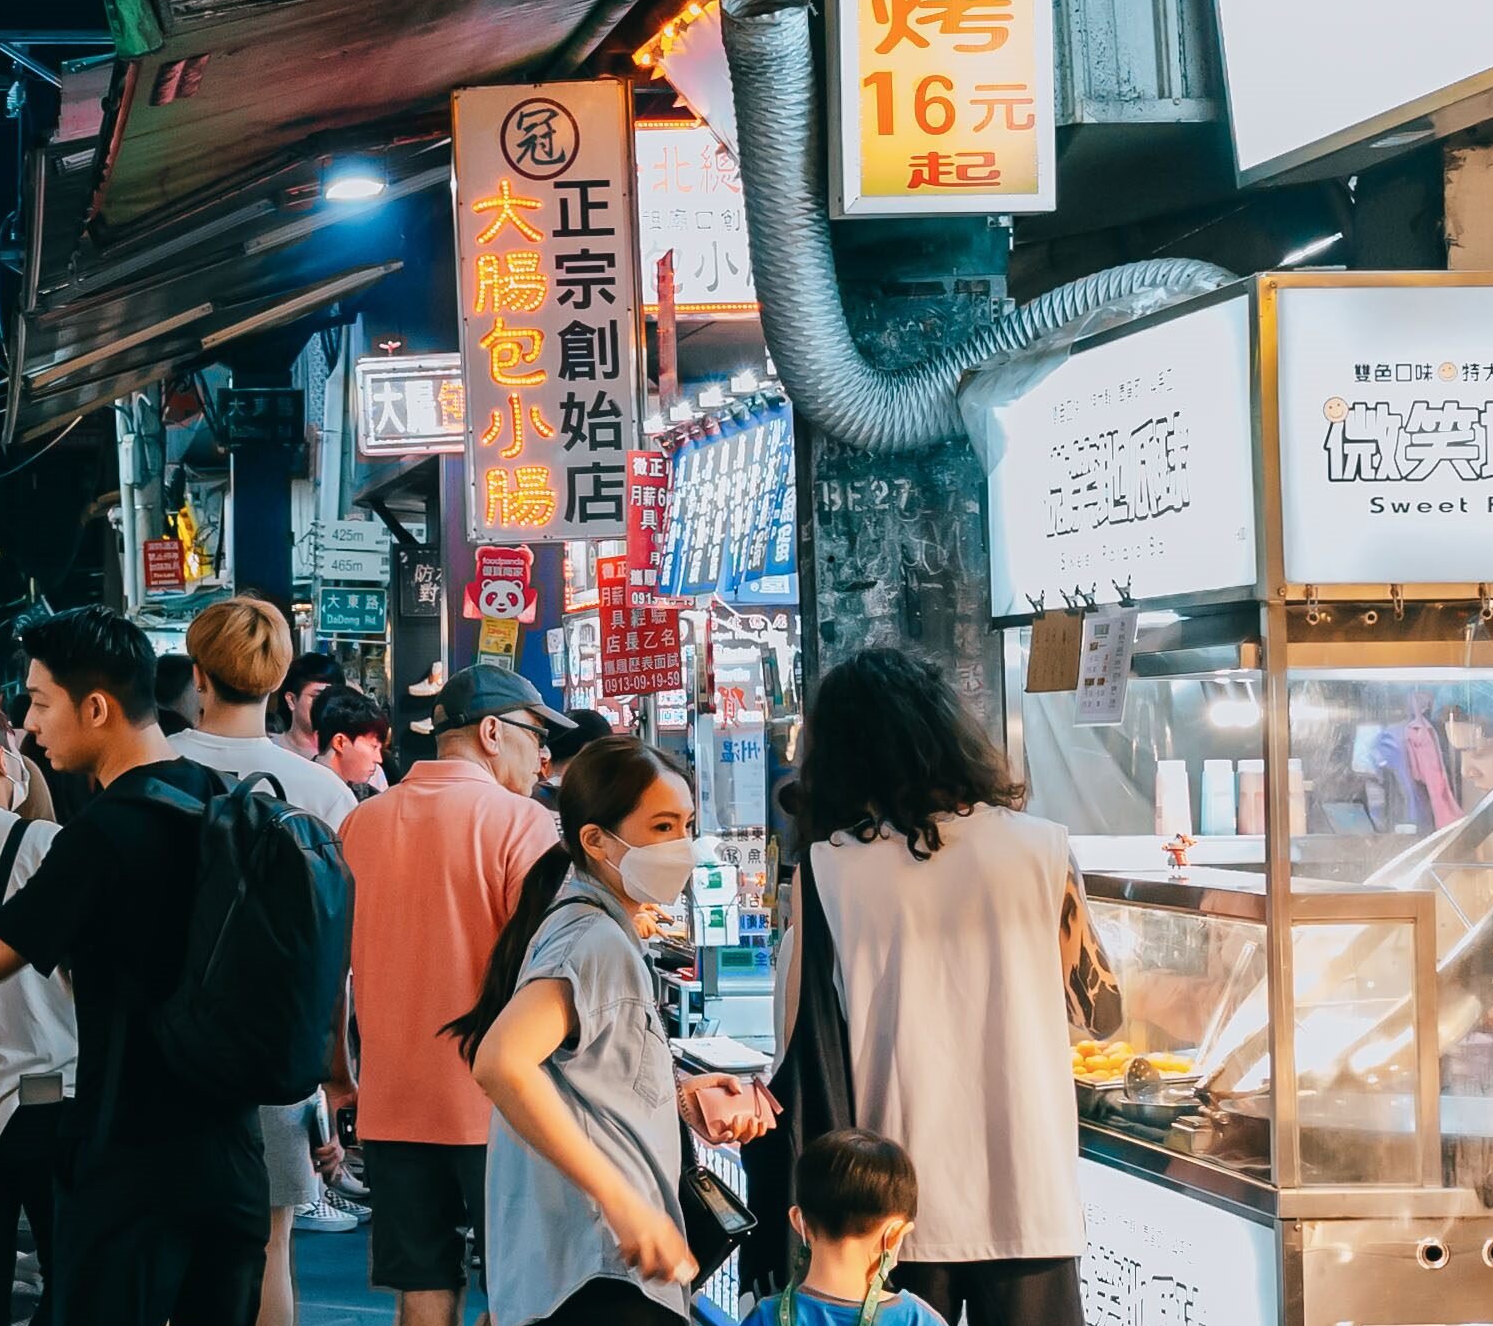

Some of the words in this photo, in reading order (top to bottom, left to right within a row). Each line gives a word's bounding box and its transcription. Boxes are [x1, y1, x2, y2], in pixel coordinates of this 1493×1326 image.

[516, 109, 567, 165] 冠
[473, 179, 558, 529] 大腸包小腸
[552, 178, 625, 526] 正宗創始店
[1354, 360, 1434, 384] 雙色口味
[1369, 494, 1470, 515] Sweet
[331, 529, 365, 543] 425m
[330, 559, 364, 573] 465m
[326, 593, 380, 610] 大東路
[606, 628, 677, 654] 店長乙名
